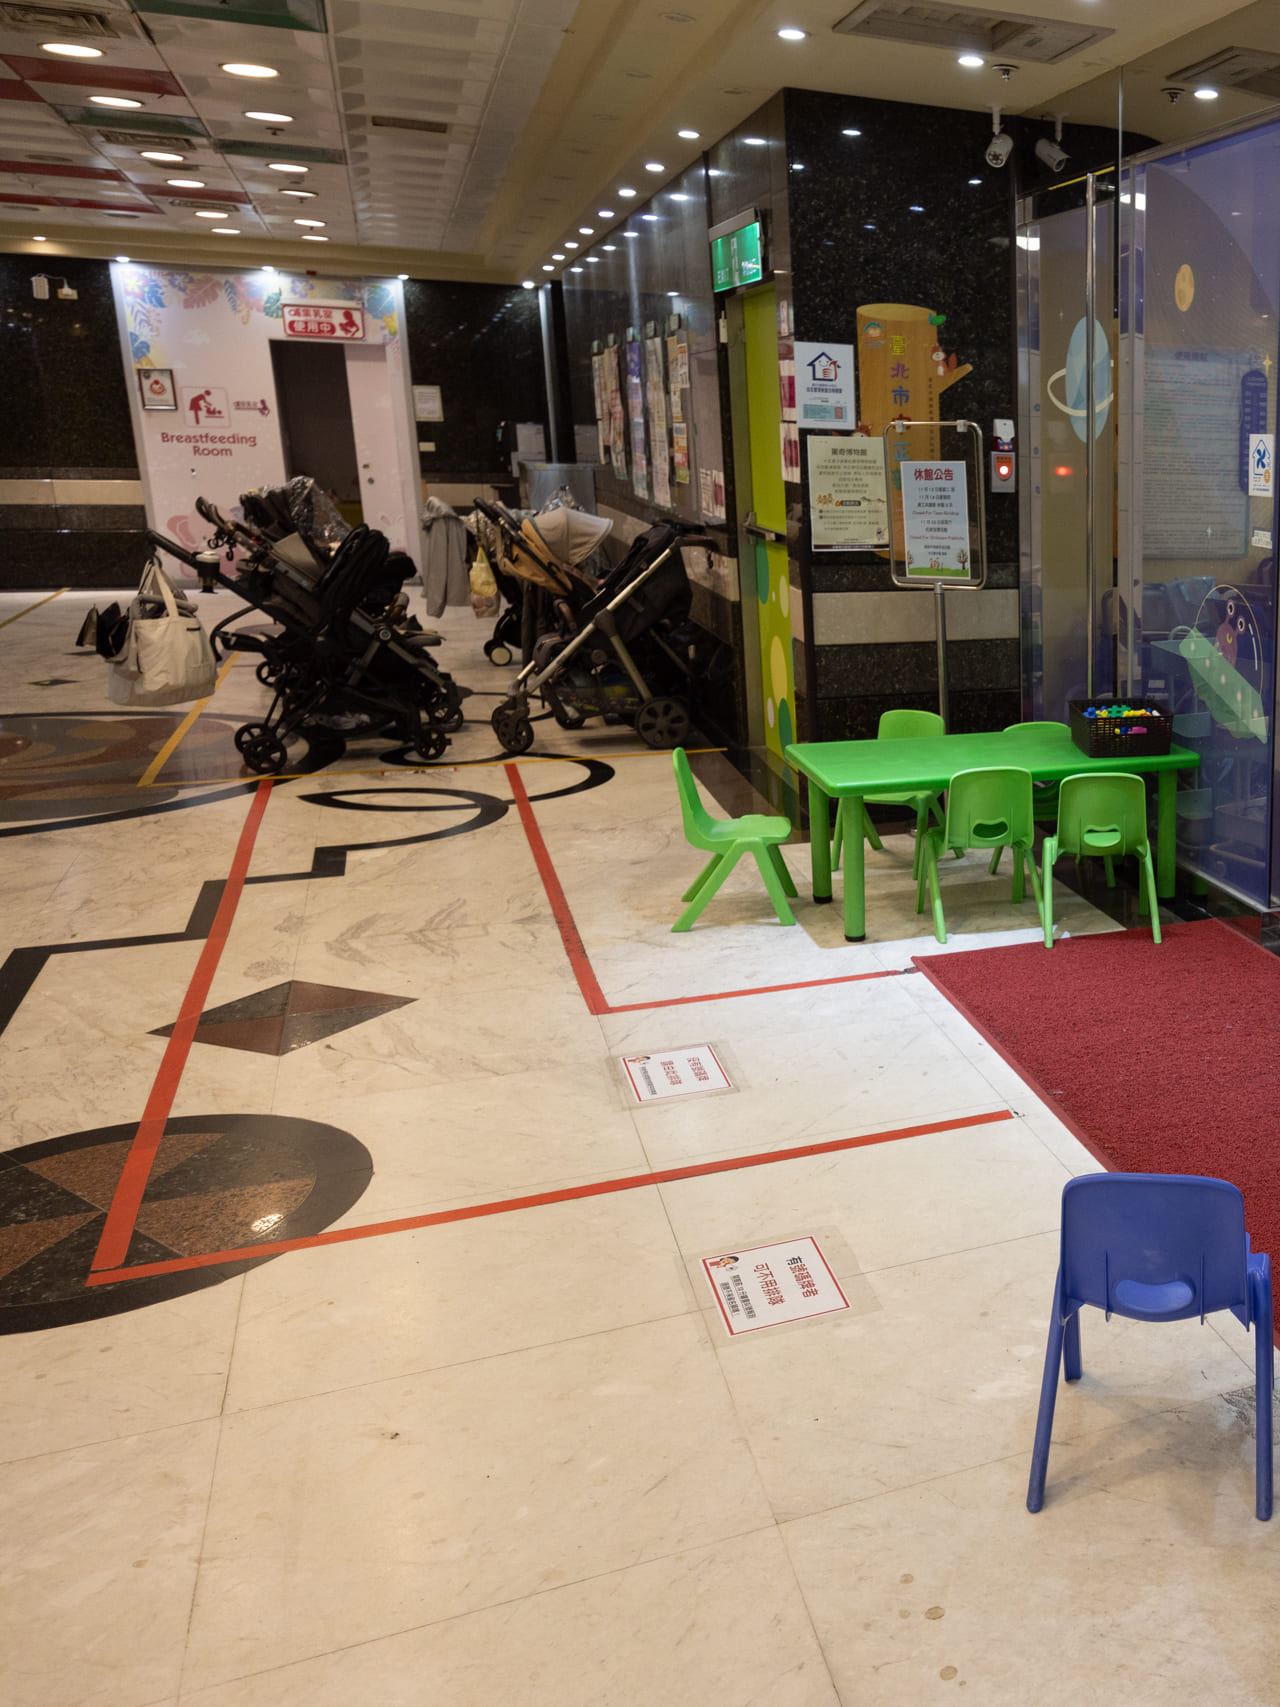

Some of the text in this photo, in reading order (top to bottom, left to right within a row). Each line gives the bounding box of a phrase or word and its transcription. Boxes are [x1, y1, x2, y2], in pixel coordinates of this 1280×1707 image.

[294, 320, 332, 334] 使用中
[161, 432, 257, 447] Breastfeeding
[193, 445, 233, 457] Room
[914, 468, 954, 481] 休館公告
[786, 1255, 819, 1298] 有號碼牌者
[753, 1262, 786, 1306] 可不用排隊
